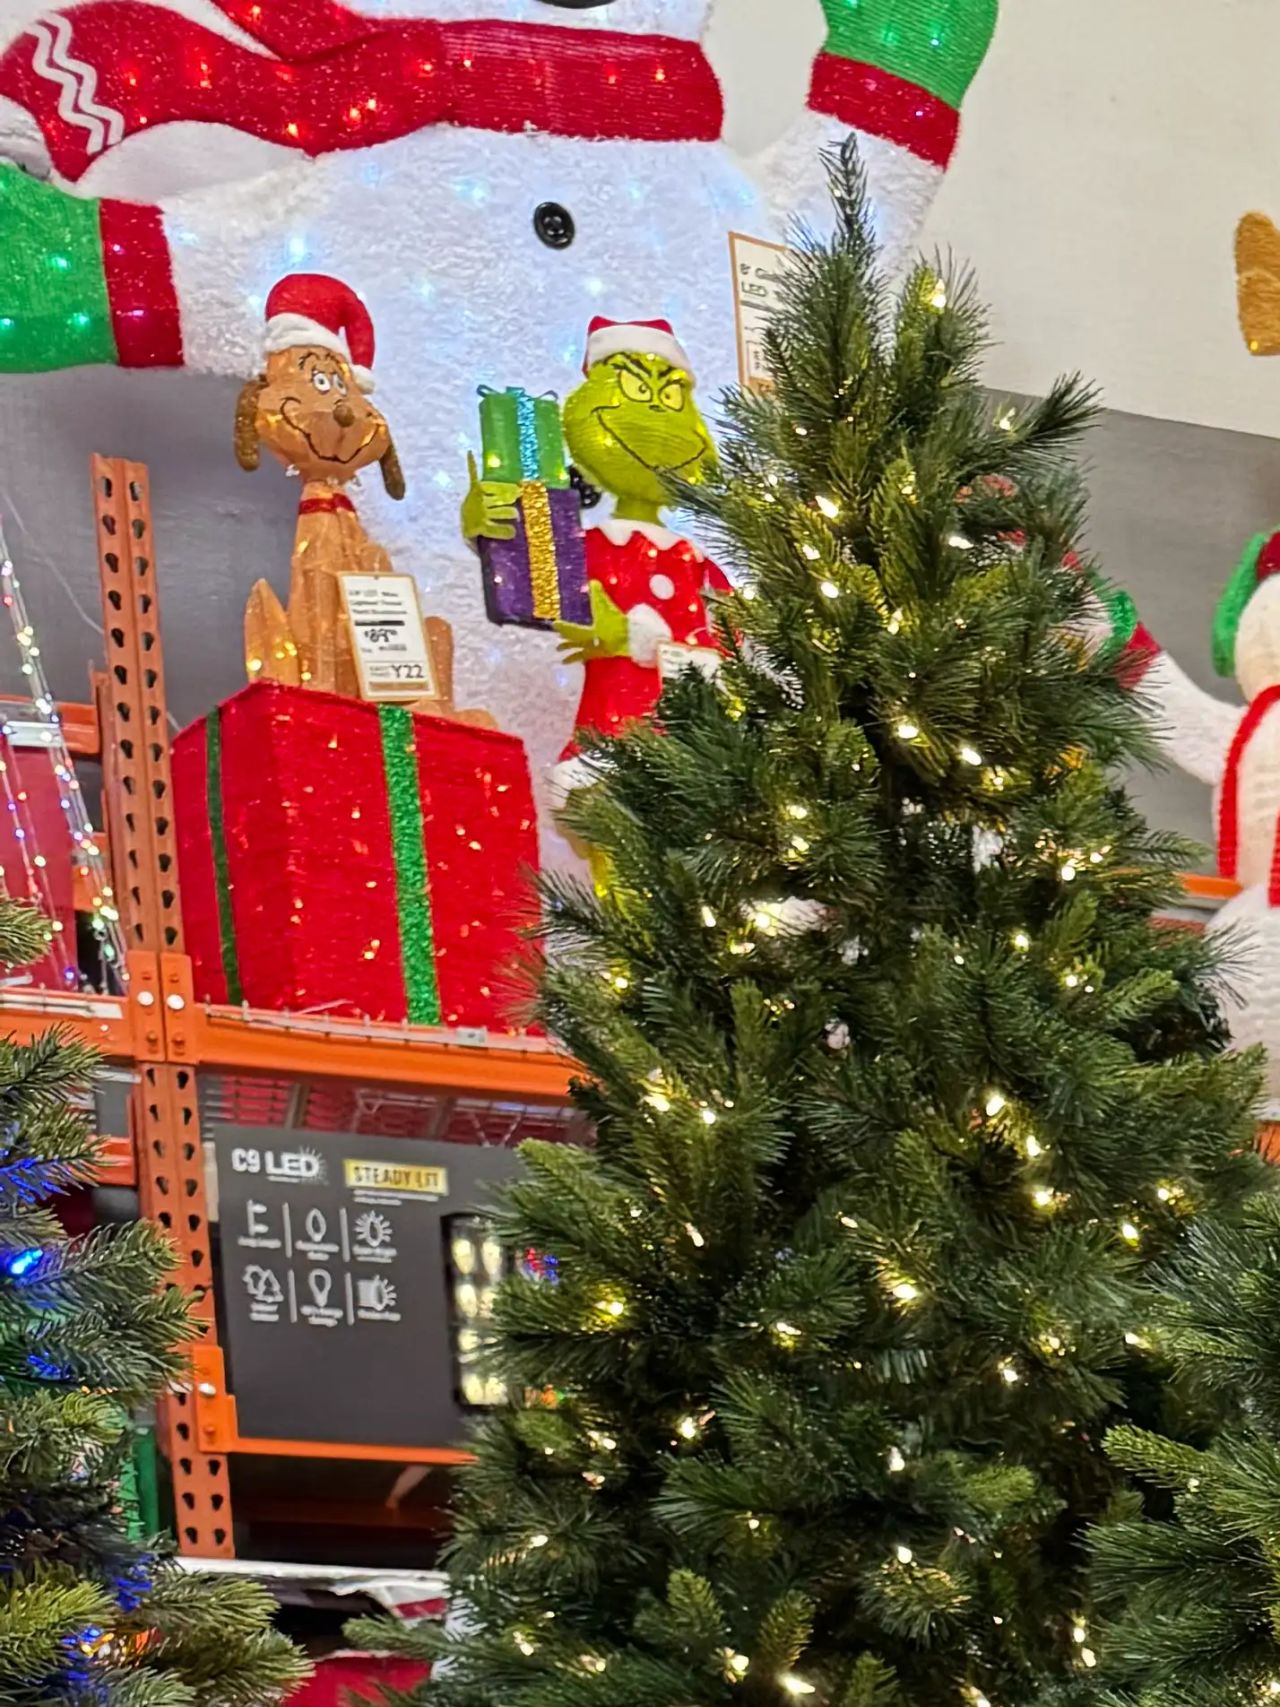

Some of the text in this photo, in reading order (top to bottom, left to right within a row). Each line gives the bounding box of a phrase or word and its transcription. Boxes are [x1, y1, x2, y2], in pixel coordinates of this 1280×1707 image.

[391, 663, 425, 680] Y22
[231, 1147, 320, 1178] C9 LED
